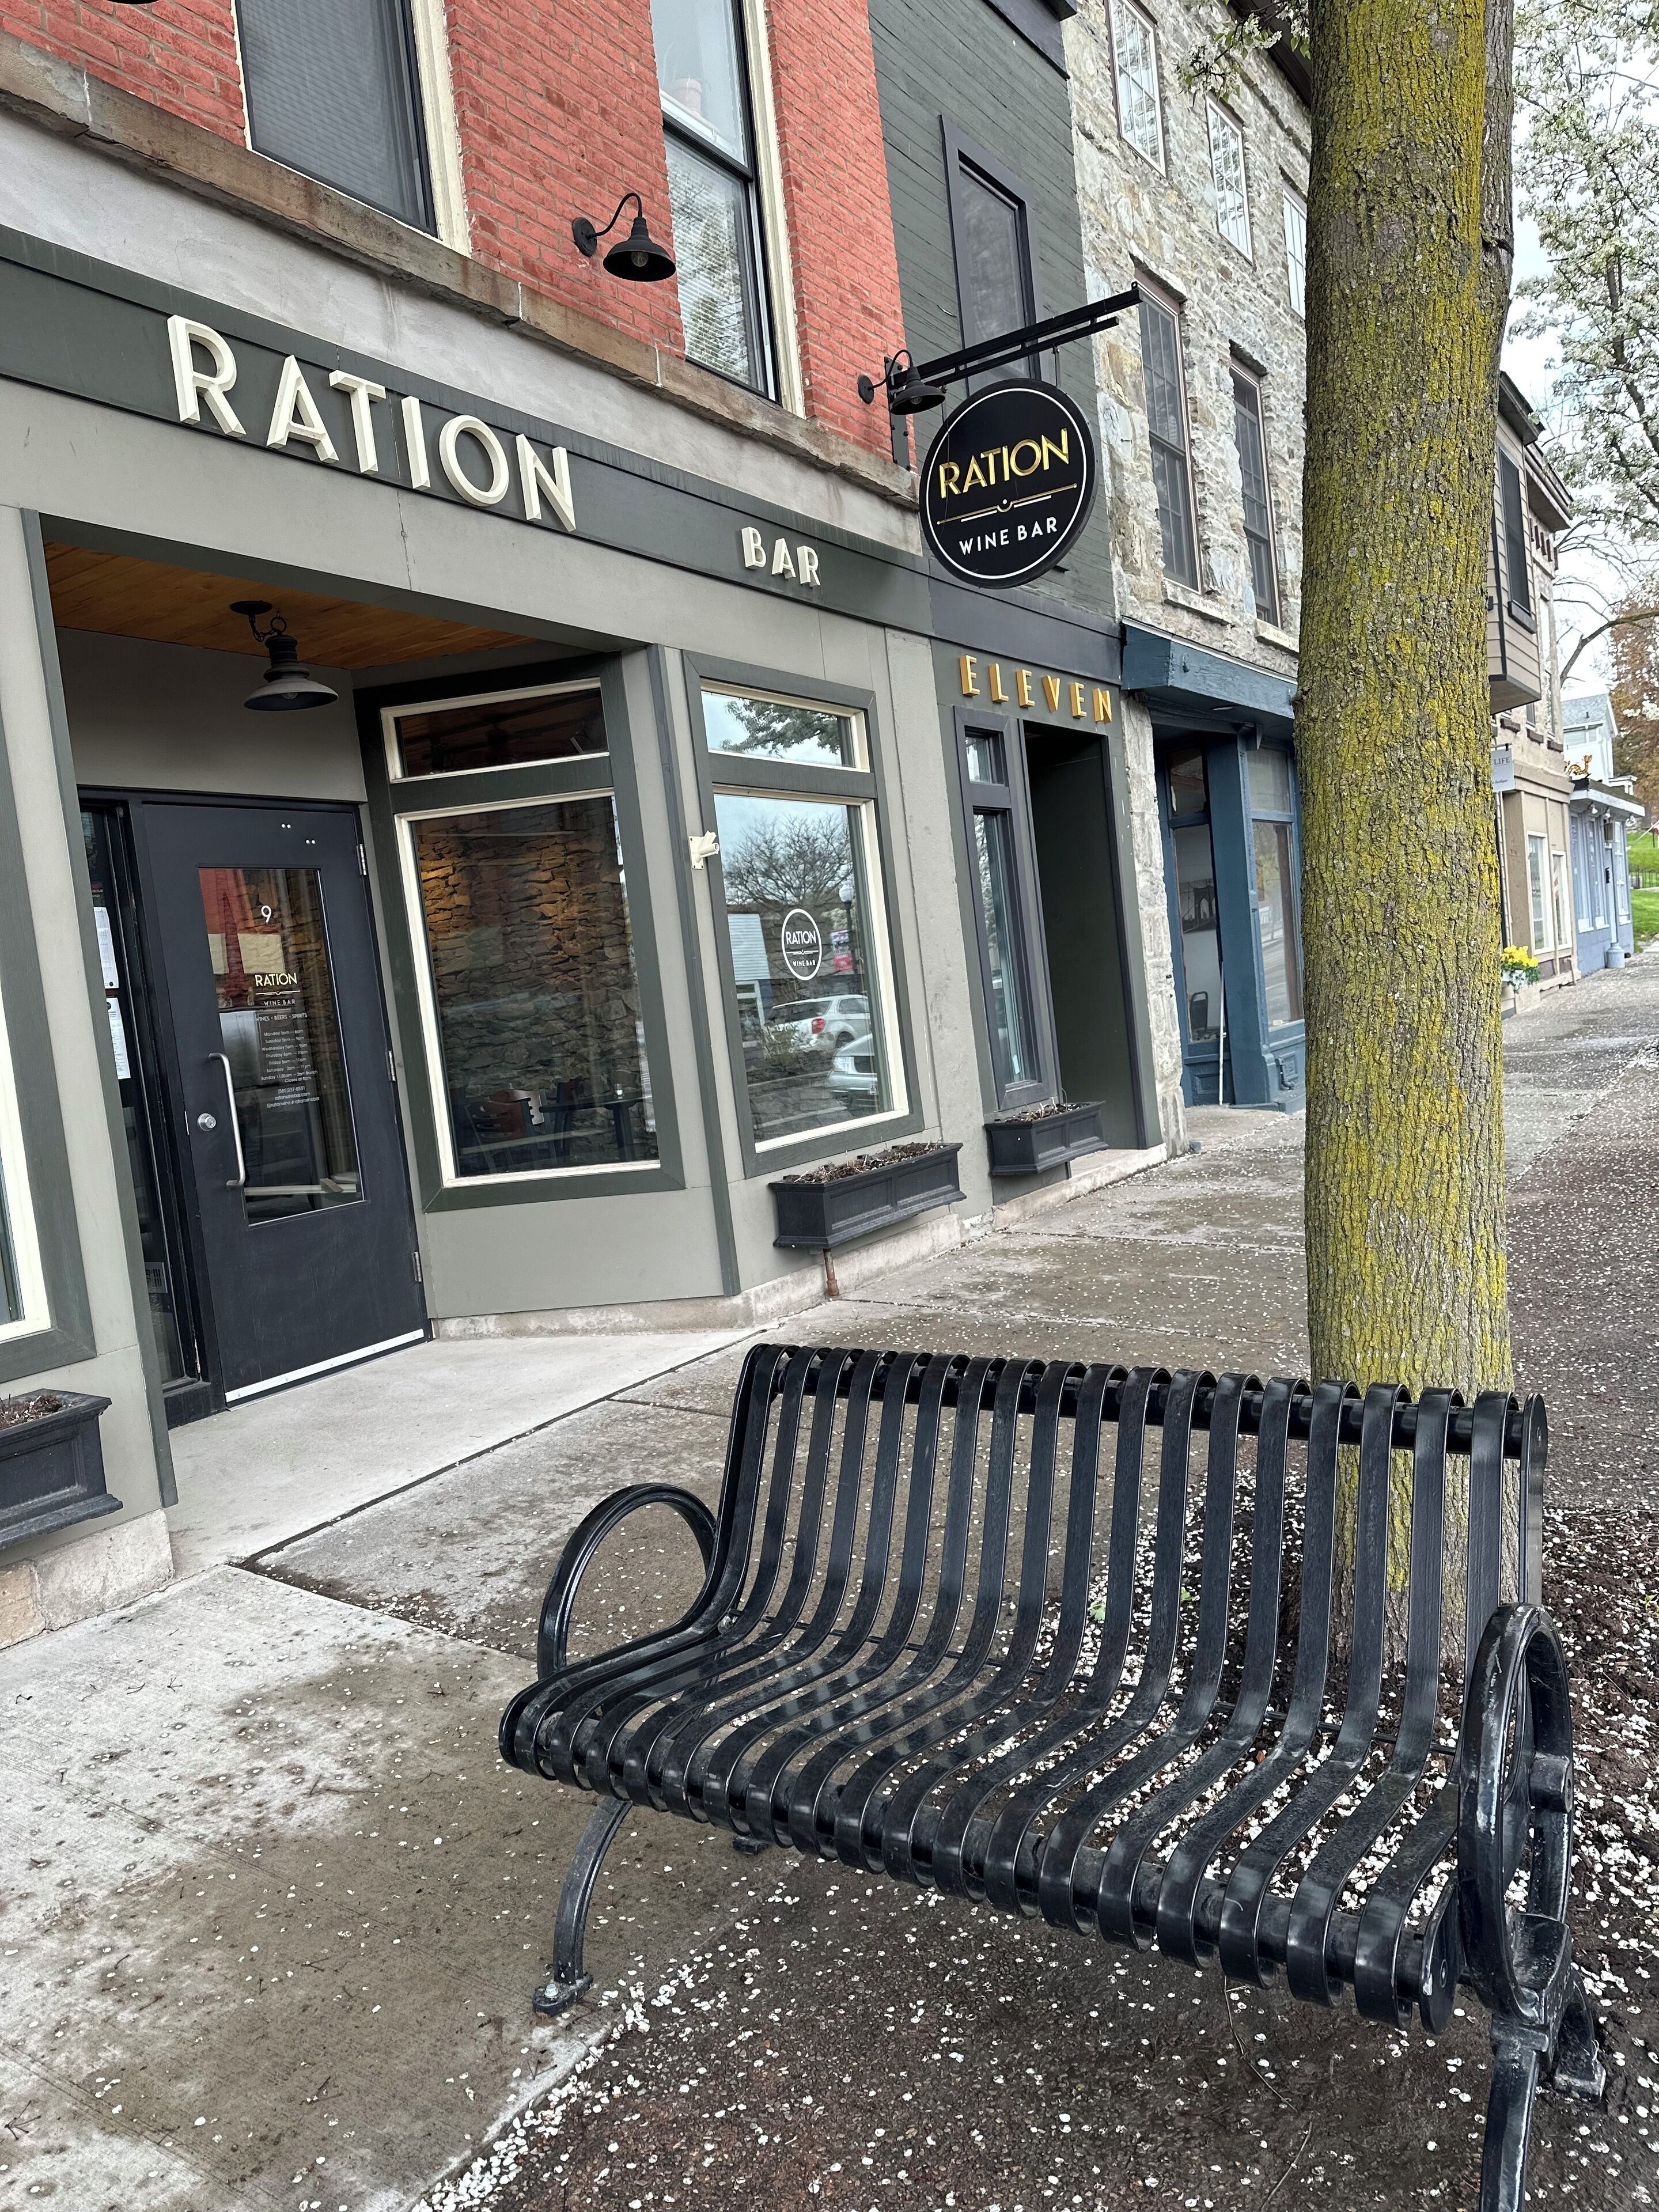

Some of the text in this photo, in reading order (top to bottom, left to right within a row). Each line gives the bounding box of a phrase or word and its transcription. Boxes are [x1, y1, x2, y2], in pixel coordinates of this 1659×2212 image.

[167, 315, 576, 532] RATION
[939, 428, 1069, 499] RATION
[959, 517, 1058, 555] WINE BAR
[741, 527, 821, 588] BAR
[959, 654, 1112, 724] ELEVEN
[1494, 757, 1510, 766] LIFE
[261, 905, 272, 923] 9
[786, 930, 817, 945] RATION
[255, 972, 297, 987] RATION
